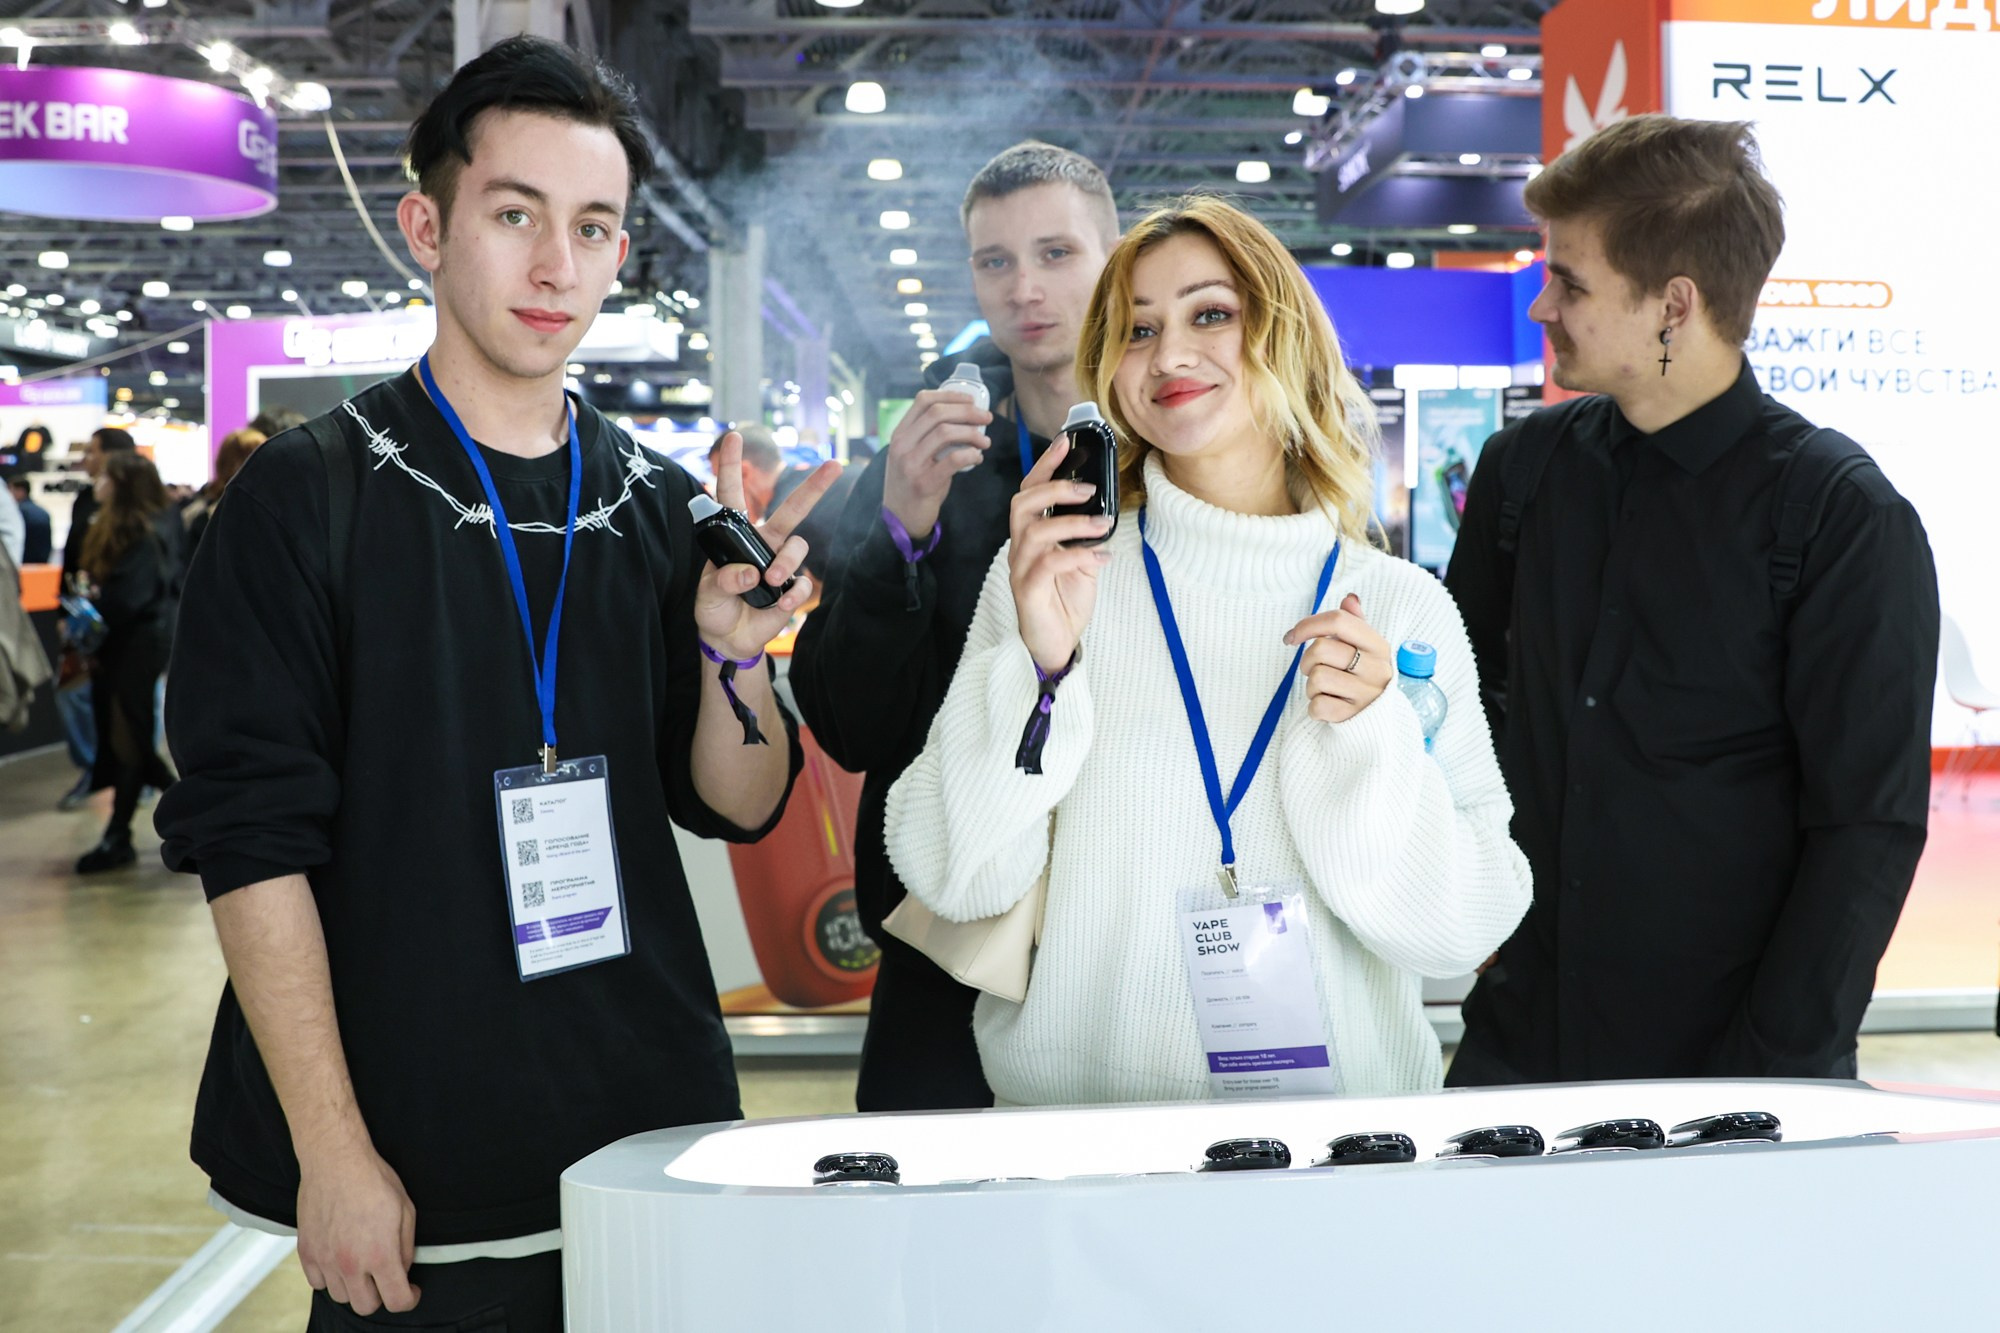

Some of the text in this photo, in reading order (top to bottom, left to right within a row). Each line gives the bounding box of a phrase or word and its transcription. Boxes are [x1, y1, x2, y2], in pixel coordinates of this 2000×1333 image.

[1712, 62, 1898, 105] RELX
[44, 101, 129, 144] BAR
[1868, 329, 1928, 354] ВСЕ
[1848, 367, 1998, 394] ЧУВСТВА
[1193, 918, 1229, 931] VAPE
[1195, 931, 1232, 943] CLUB
[1197, 942, 1240, 956] SHOW
